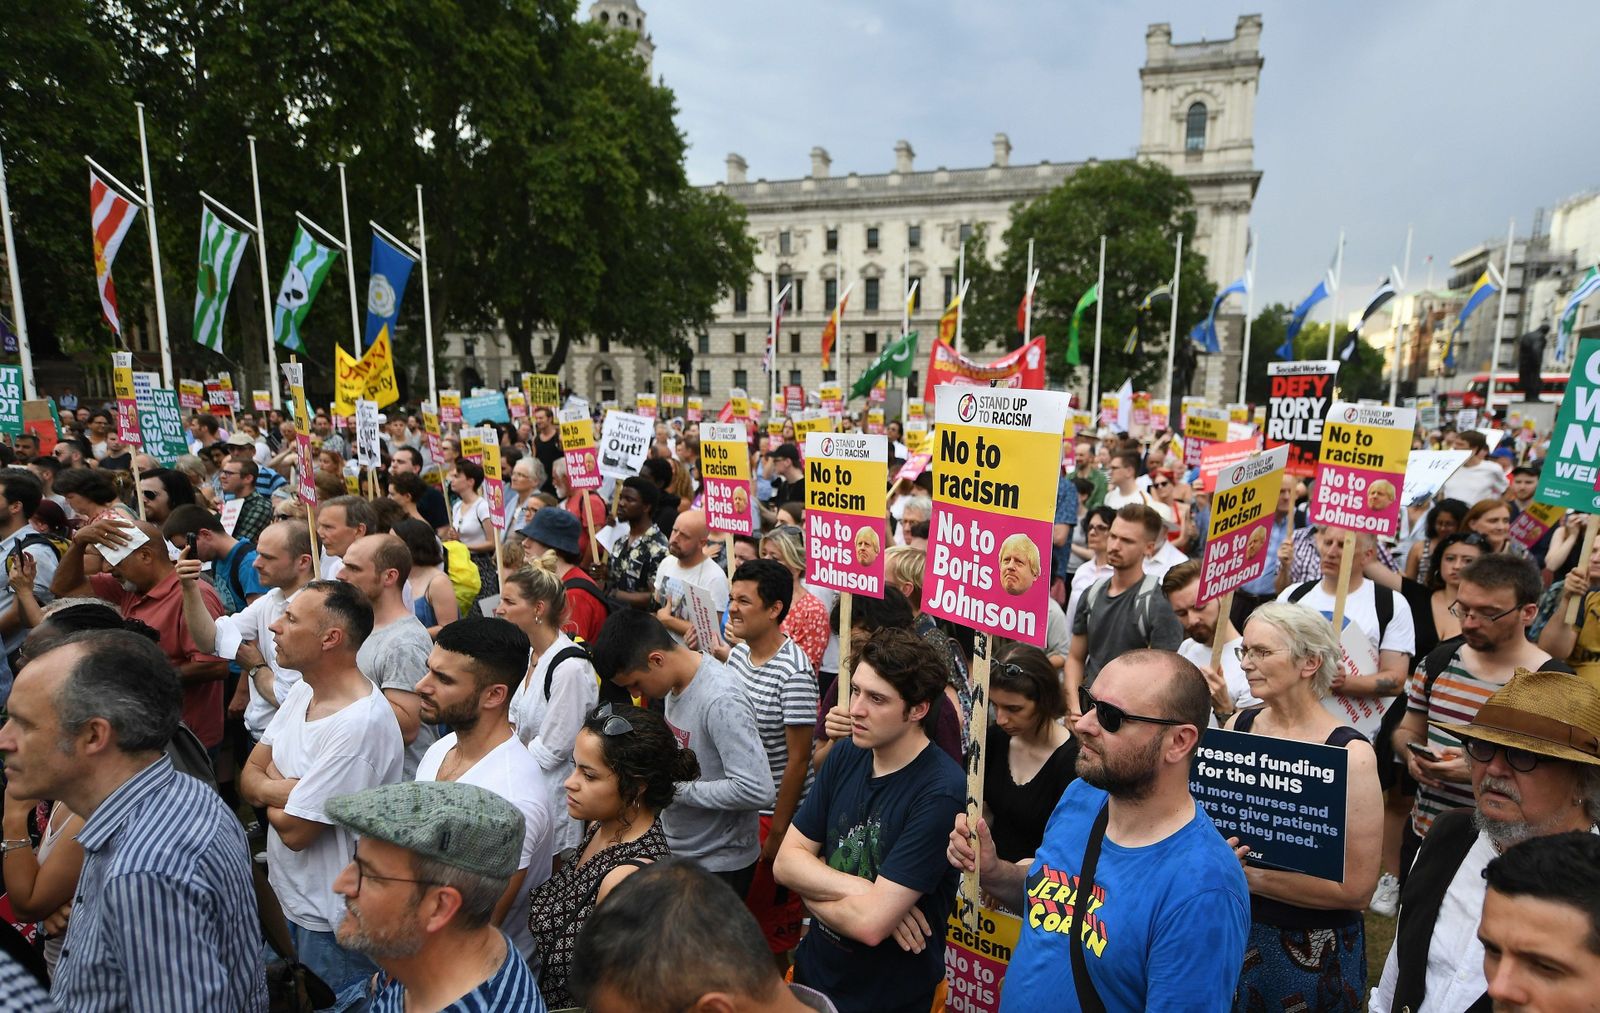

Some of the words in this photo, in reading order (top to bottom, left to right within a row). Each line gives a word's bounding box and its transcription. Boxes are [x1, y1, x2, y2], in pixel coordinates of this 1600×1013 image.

[1302, 364, 1328, 372] Worker
[1271, 374, 1330, 398] DEFY
[154, 391, 175, 407] CUT
[979, 396, 1010, 410] STAND
[1012, 398, 1028, 412] UP
[1269, 396, 1327, 420] TORY
[156, 406, 179, 421] WAR
[979, 410, 990, 424] TO
[992, 411, 1032, 427] RACISM
[1368, 418, 1395, 426] RACISM
[160, 420, 181, 436] NOT
[562, 426, 570, 436] No
[571, 425, 578, 434] to
[608, 429, 646, 444] Johnson
[618, 422, 640, 434] Kick
[1268, 418, 1324, 442] RULE
[1328, 426, 1351, 444] No
[1356, 430, 1373, 446] to
[564, 436, 586, 448] racism
[608, 438, 642, 456] Out!
[704, 444, 716, 459] No
[718, 445, 728, 459] to
[836, 438, 856, 448] STAND
[856, 440, 866, 448] UP
[836, 448, 844, 456] TO
[844, 449, 870, 459] RACISM
[940, 430, 970, 465] No
[976, 435, 1001, 469] to
[566, 452, 575, 464] No
[575, 452, 584, 462] to
[568, 464, 586, 476] Boris
[706, 461, 737, 476] racism
[1246, 460, 1264, 472] STAND
[1264, 456, 1273, 466] UP
[1326, 448, 1384, 468] racism
[571, 475, 600, 488] Johnson
[810, 461, 831, 484] No
[835, 464, 852, 486] to
[1246, 470, 1253, 480] TO
[1252, 463, 1274, 478] RACISM
[1321, 468, 1344, 488] No
[1348, 472, 1366, 492] to
[1555, 461, 1598, 484] WEL
[706, 480, 720, 498] No
[720, 482, 732, 498] to
[810, 488, 866, 511] racism
[939, 470, 1020, 510] racism
[1216, 492, 1237, 515] No
[1242, 487, 1256, 506] to
[1318, 485, 1364, 510] Boris
[708, 496, 733, 514] Boris
[708, 512, 750, 532] Johnson
[810, 515, 831, 539] No
[834, 519, 852, 542] to
[1212, 502, 1262, 536] racism
[1314, 504, 1390, 532] Johnson
[936, 510, 965, 548] No
[970, 520, 996, 554] to
[810, 537, 852, 566] Boris
[1208, 540, 1229, 564] No
[1232, 534, 1248, 553] to
[810, 560, 878, 594] Johnson
[932, 544, 994, 592] Boris
[1204, 552, 1244, 582] Boris
[1200, 562, 1260, 601] Johnson
[927, 578, 1036, 638] Johnson
[1195, 746, 1256, 767] reased
[1260, 754, 1335, 784] funding
[1198, 762, 1224, 780] for
[1226, 768, 1256, 786] the
[1260, 772, 1302, 794] NHS
[1207, 786, 1243, 801] more
[1246, 794, 1296, 812] nurses
[1300, 804, 1329, 819] and
[1222, 802, 1236, 815] to
[1238, 806, 1270, 822] give
[1272, 814, 1338, 837] patients
[1240, 821, 1273, 842] they
[1276, 830, 1319, 849] need.
[977, 910, 996, 934] to
[1028, 902, 1108, 959] CORYN
[946, 923, 1011, 962] racism
[944, 945, 969, 973] No
[973, 960, 994, 984] to
[945, 966, 994, 1005] Boris
